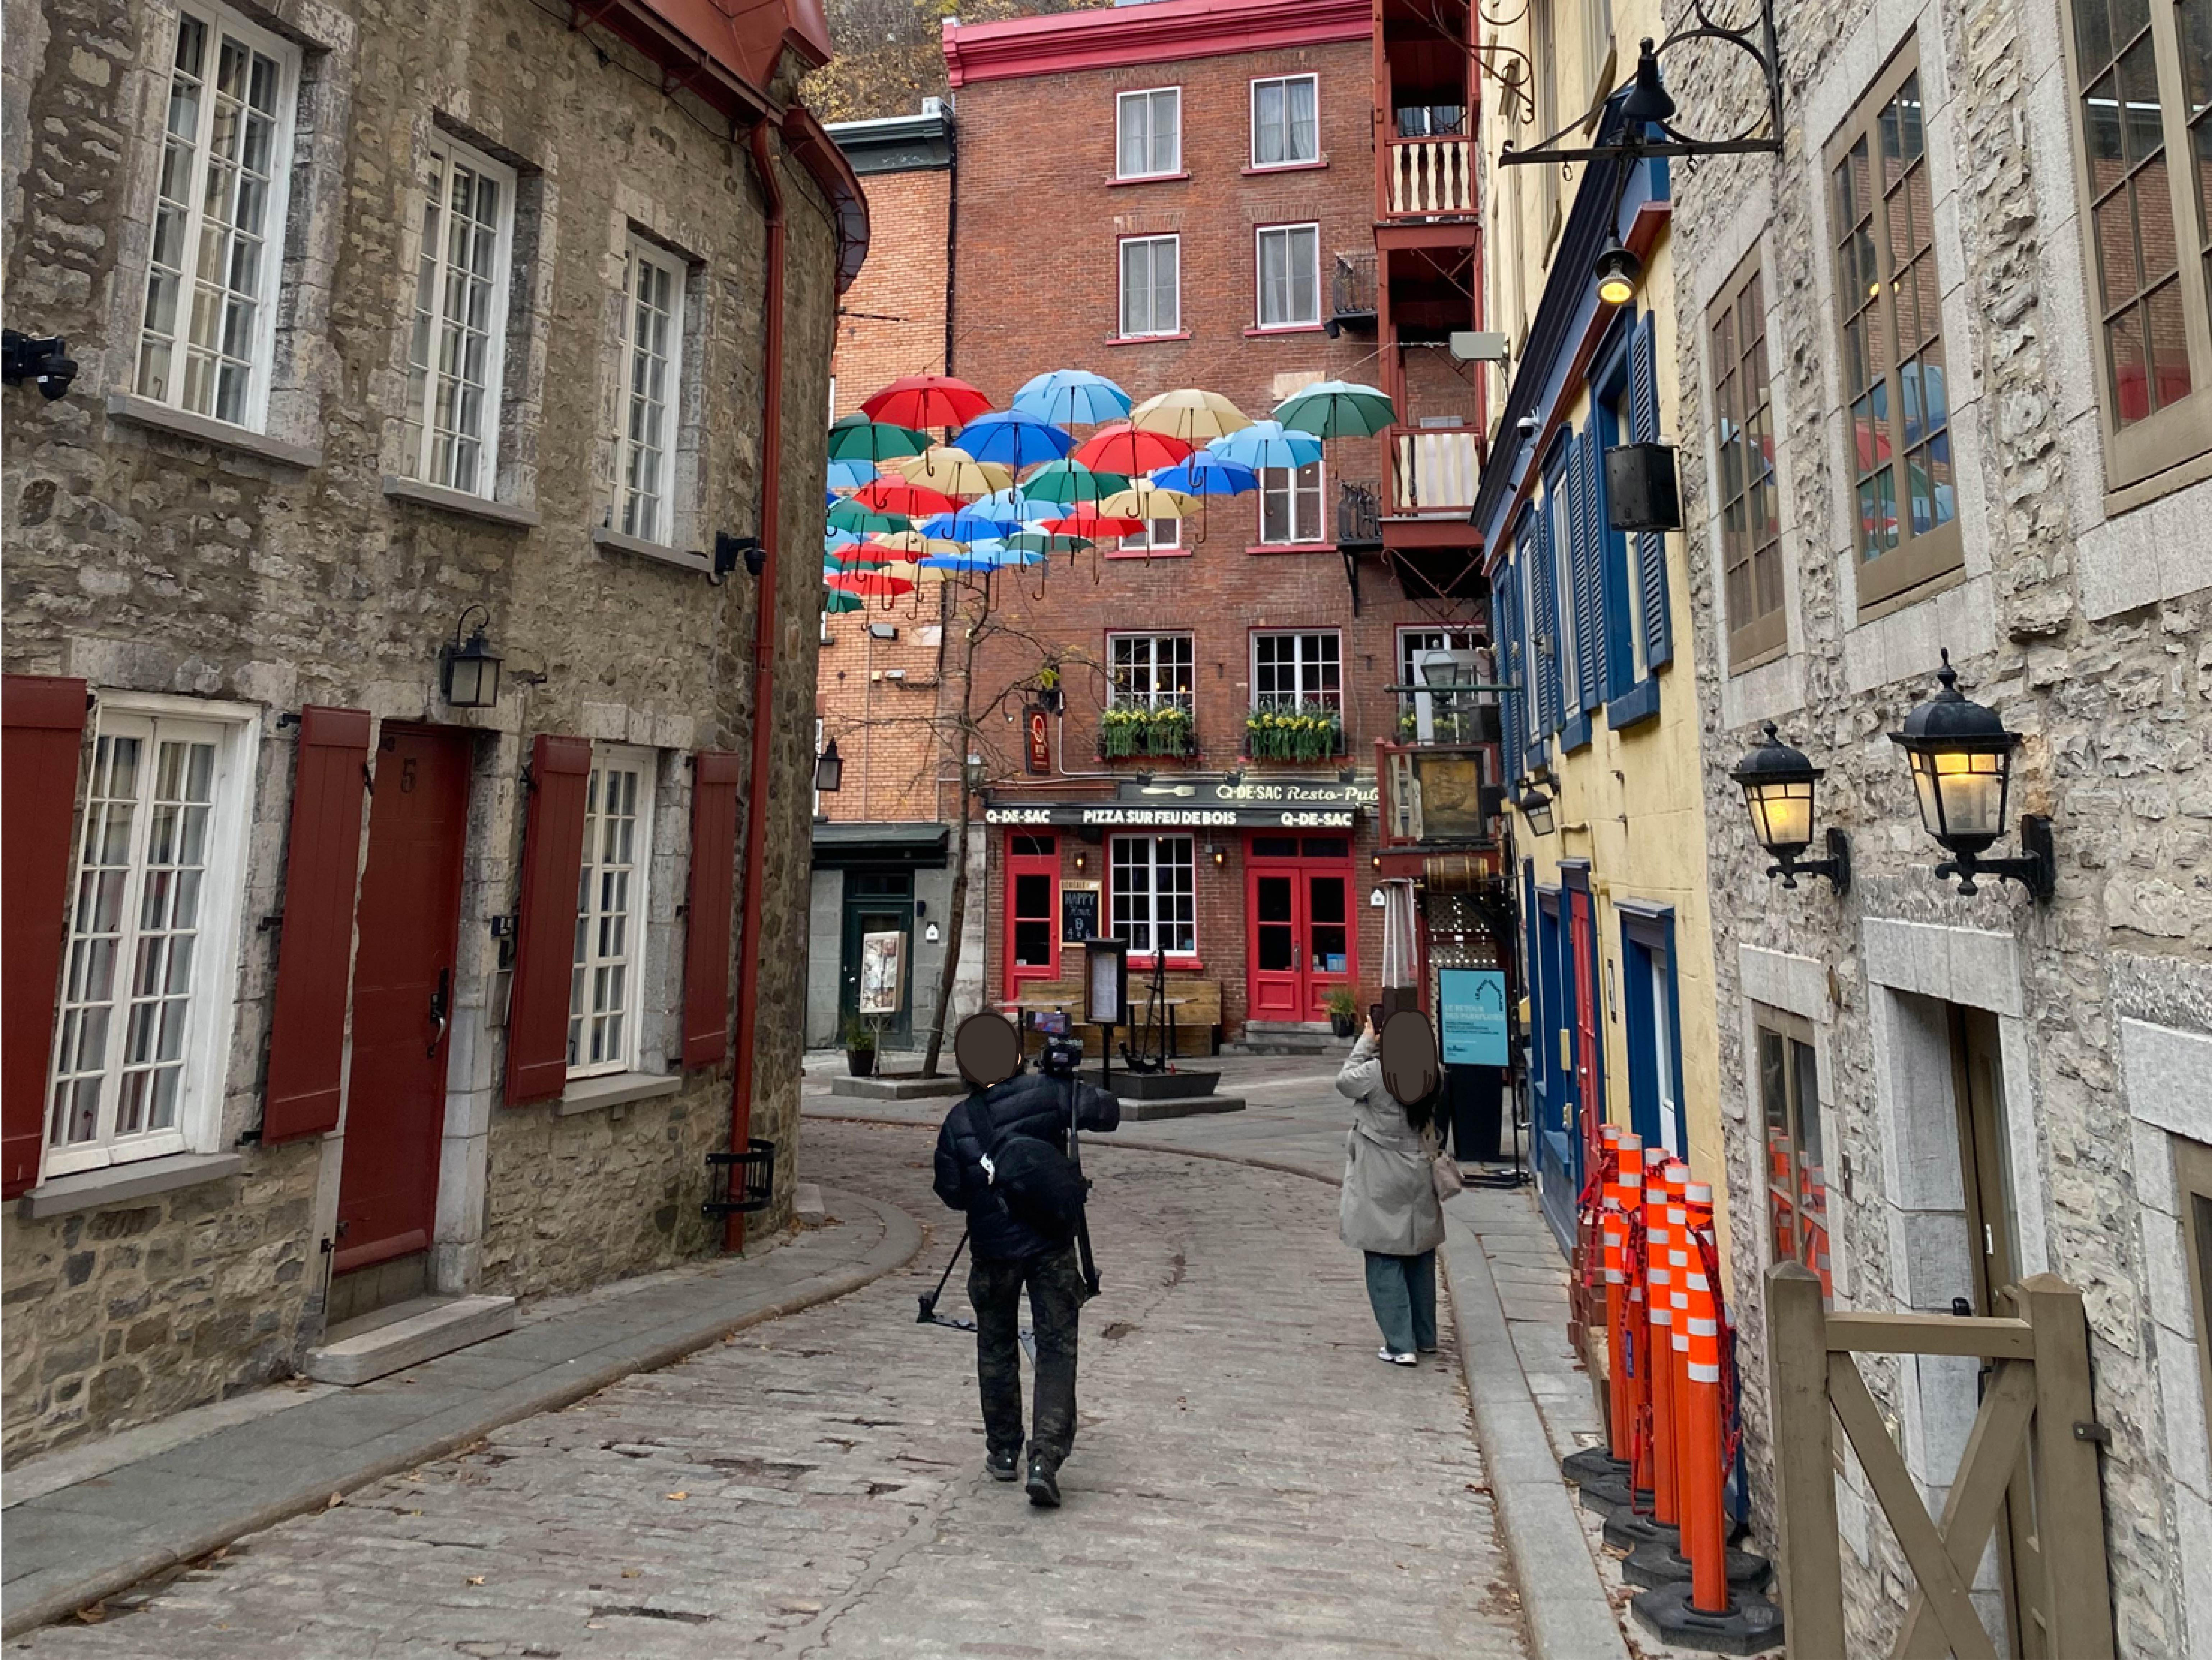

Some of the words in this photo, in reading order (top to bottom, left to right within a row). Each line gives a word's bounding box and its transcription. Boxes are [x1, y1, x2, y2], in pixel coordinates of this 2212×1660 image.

[400, 758, 416, 794] 5
[1083, 810, 1124, 823] PIZZA
[1126, 810, 1153, 824] SUR
[1155, 810, 1180, 824] FEU
[1182, 811, 1201, 824] DE
[1202, 811, 1236, 825] BOIS
[1281, 811, 1351, 826] Q-DE-SAC
